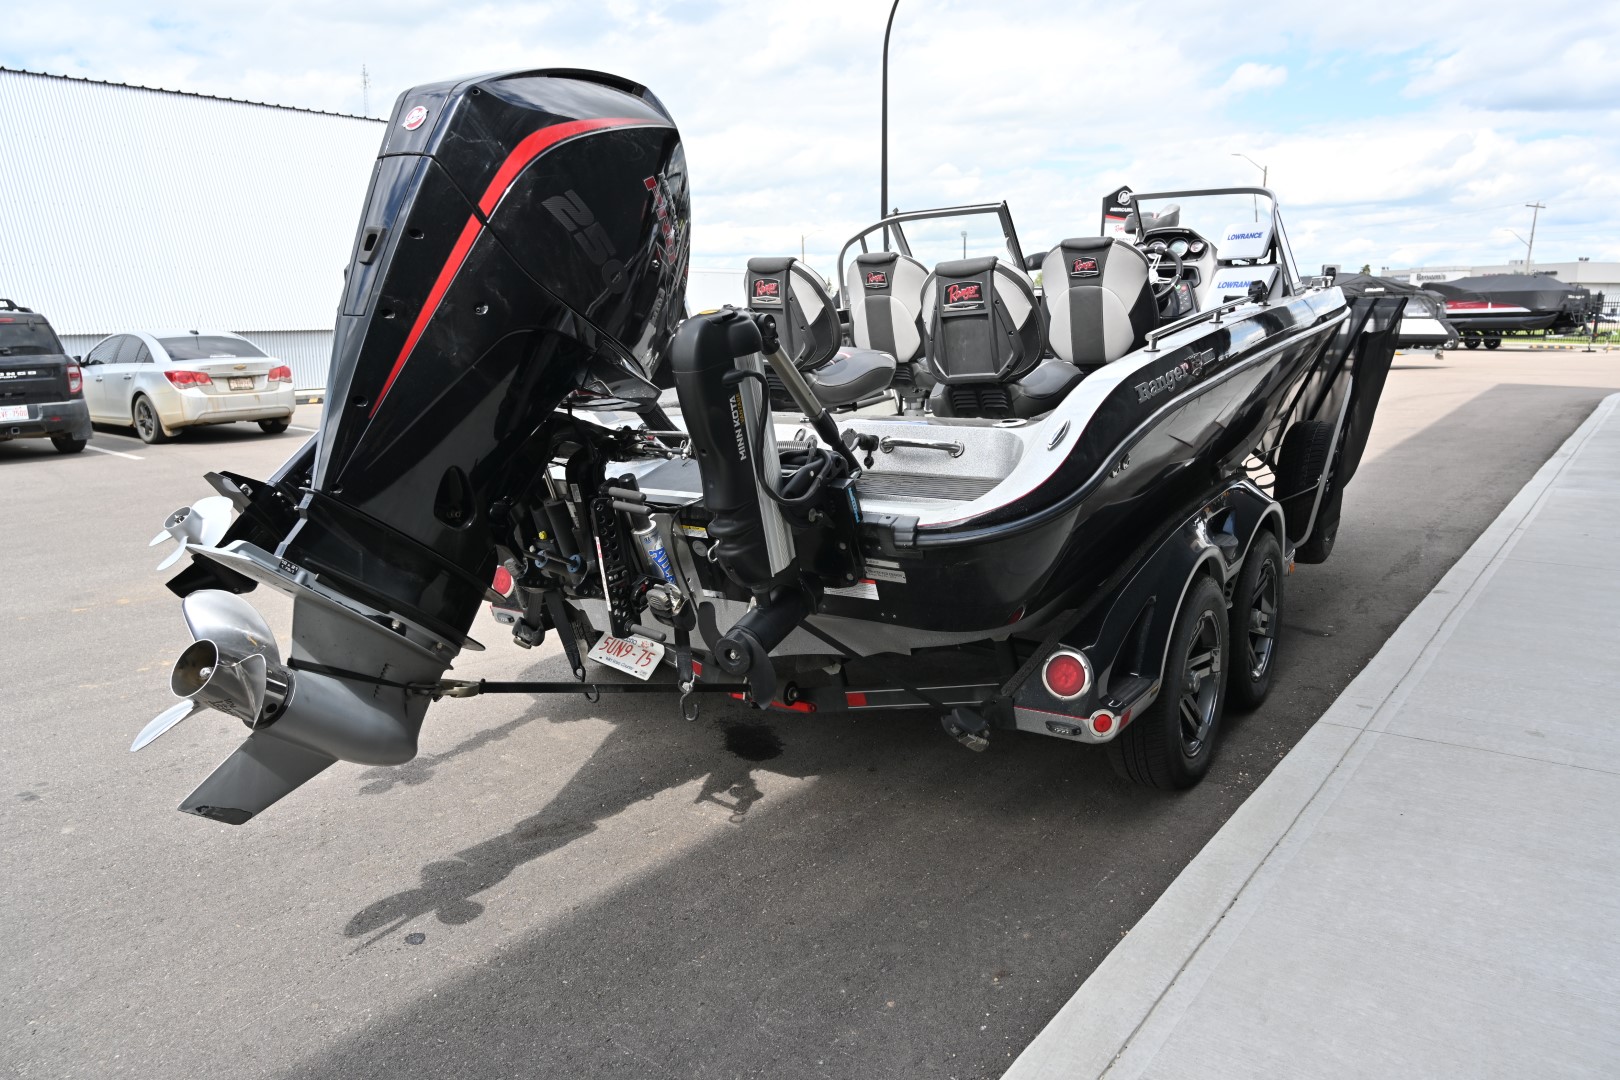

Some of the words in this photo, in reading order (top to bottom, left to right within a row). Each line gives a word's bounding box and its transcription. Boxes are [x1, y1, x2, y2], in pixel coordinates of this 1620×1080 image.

[541, 189, 628, 294] 250
[1227, 231, 1263, 241] LOWRANCE
[755, 280, 778, 297] Ranger
[947, 284, 980, 304] Ranger
[1216, 280, 1252, 289] LOWRAN
[1134, 362, 1190, 403] Ranger
[729, 394, 741, 428] KOTA
[735, 428, 747, 461] MINN
[599, 636, 656, 667] 5UN9-75
